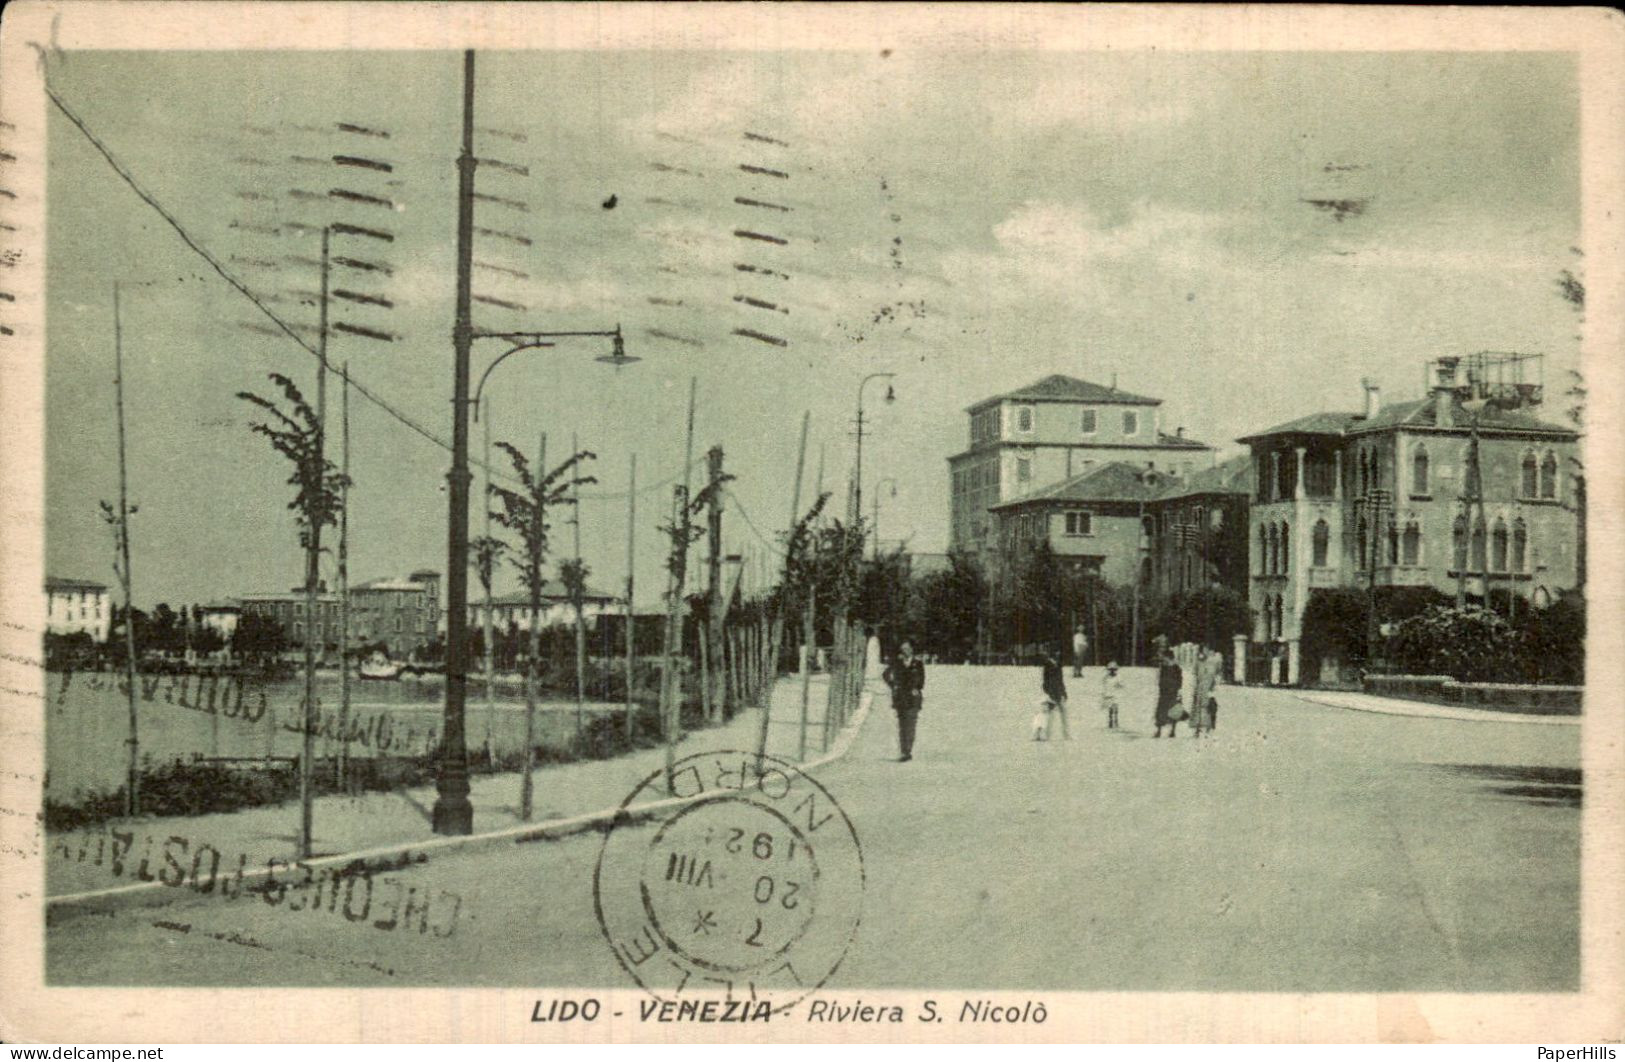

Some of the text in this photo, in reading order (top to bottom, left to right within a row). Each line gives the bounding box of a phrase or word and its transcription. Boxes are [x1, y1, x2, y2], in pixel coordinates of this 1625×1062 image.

[669, 760, 833, 832] NORD
[665, 852, 800, 910] 20 VIII
[744, 917, 764, 948] 7
[531, 998, 601, 1022] LIDO
[640, 999, 772, 1023] VENEZIA
[807, 999, 904, 1023] Riviera
[918, 999, 943, 1023] S.
[959, 1000, 1048, 1023] Nicolò
